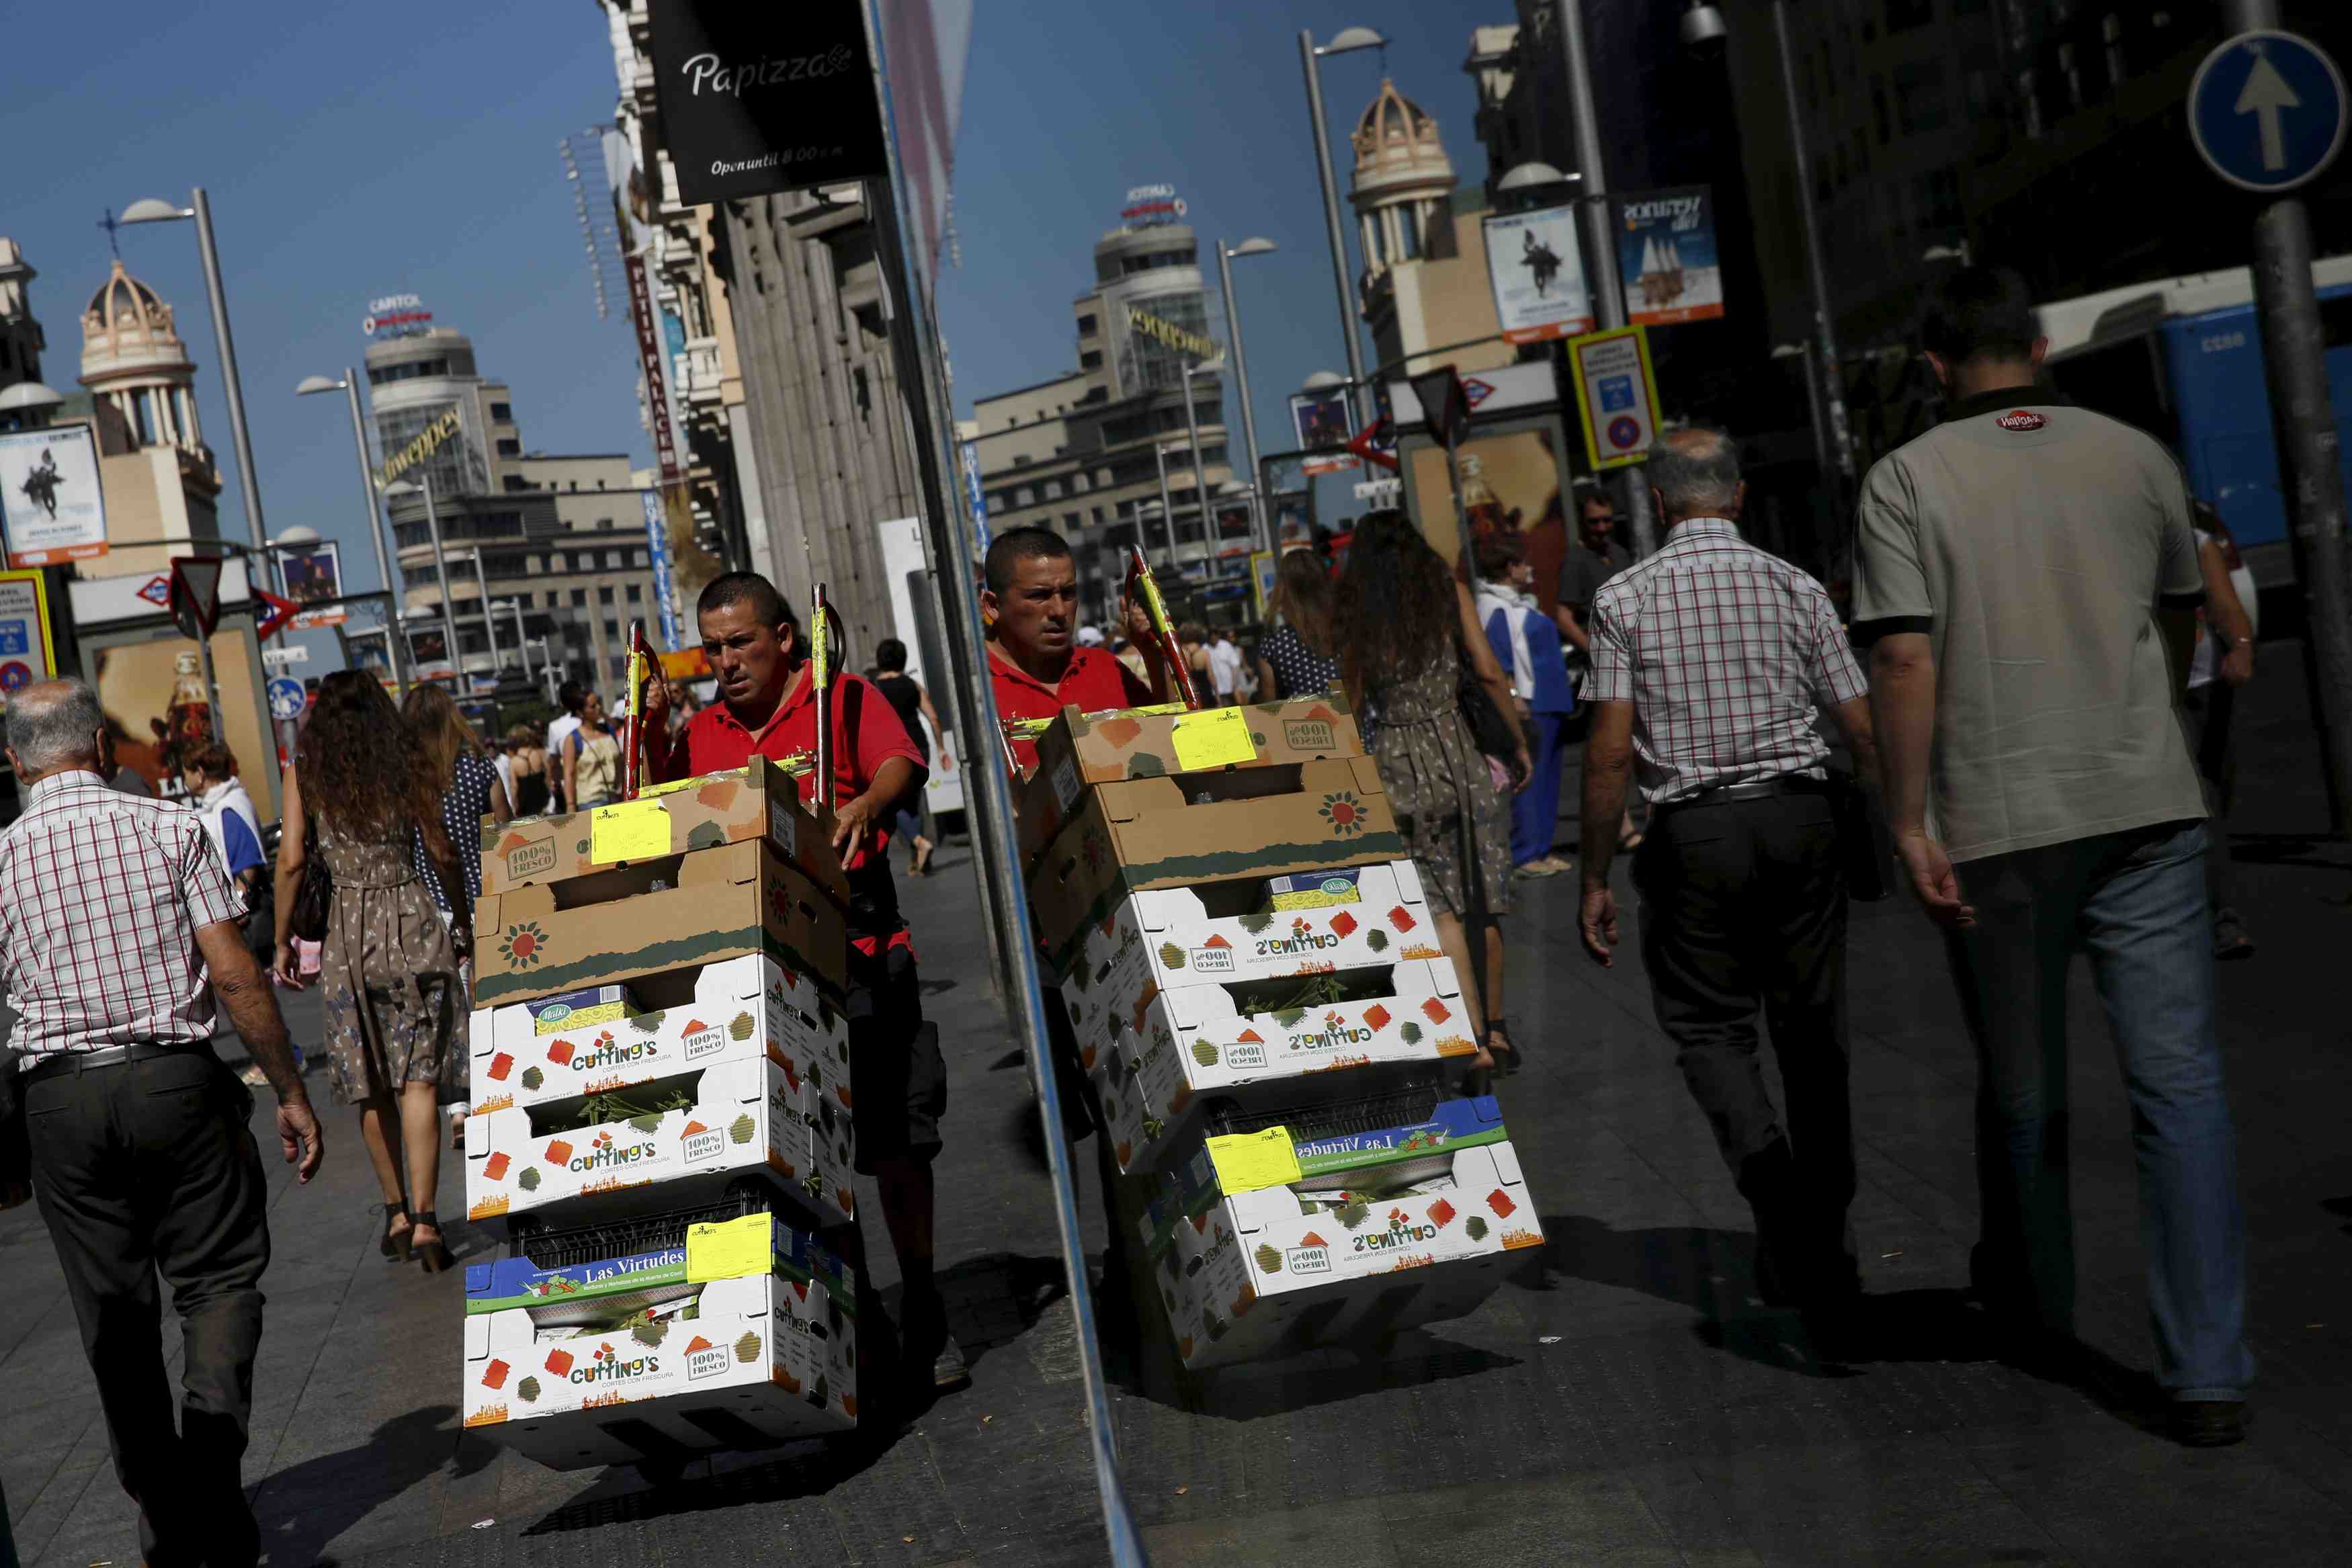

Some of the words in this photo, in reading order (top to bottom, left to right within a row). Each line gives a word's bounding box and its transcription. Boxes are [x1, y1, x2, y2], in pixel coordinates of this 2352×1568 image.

[682, 52, 834, 97] Papizza
[711, 160, 745, 176] Open
[746, 150, 778, 169] until
[512, 844, 551, 864] 100%
[513, 857, 552, 874] FRESCO
[543, 1008, 567, 1020] Malki
[687, 1031, 720, 1047] 100%
[689, 1041, 721, 1055] FRESCO
[602, 1062, 625, 1074] CORTES
[626, 1060, 639, 1070] CON
[640, 1054, 672, 1067] FRESCURA
[686, 1135, 720, 1151] 100%
[689, 1144, 720, 1159] FRESCO
[600, 1164, 624, 1175] CORTES
[624, 1162, 638, 1171] CON
[639, 1156, 670, 1168] FRESCURA
[585, 1266, 613, 1284] Las
[617, 1250, 684, 1274] Virtudes
[691, 1352, 726, 1366] 100%
[693, 1361, 726, 1375] FRESCO
[602, 1378, 626, 1388] CORTES
[627, 1377, 640, 1385] CON
[642, 1371, 674, 1383] FRESCURA
